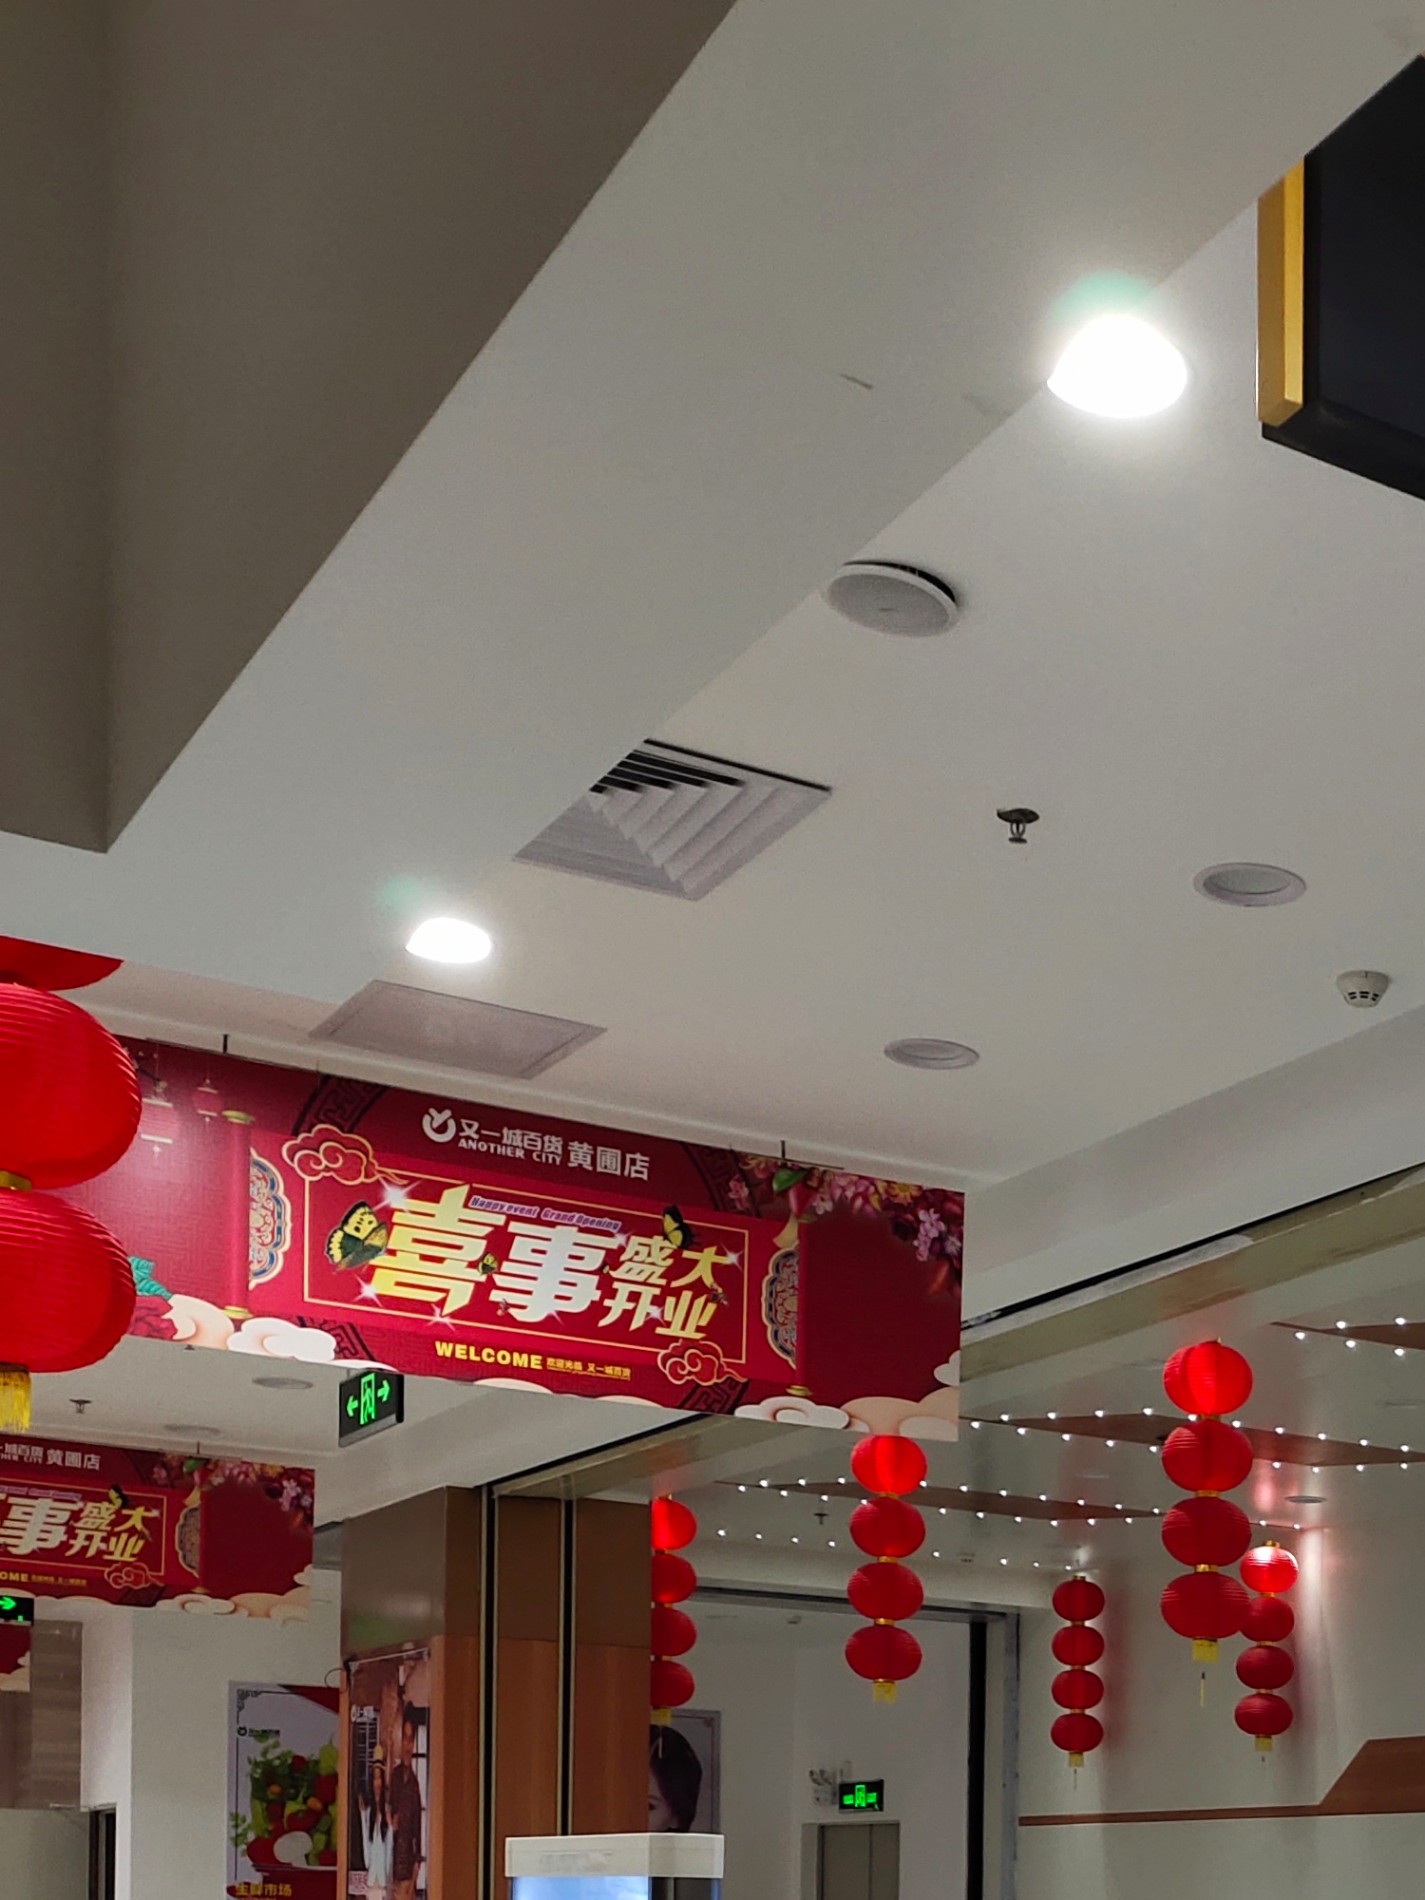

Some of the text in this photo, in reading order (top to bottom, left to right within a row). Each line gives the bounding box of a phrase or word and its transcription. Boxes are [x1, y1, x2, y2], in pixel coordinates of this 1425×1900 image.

[458, 1138, 563, 1166] ANOTHER CITY
[459, 1118, 650, 1181] 又一城百货 黄圃店
[609, 1235, 735, 1287] 盛大
[598, 1282, 718, 1339] 开业
[435, 1341, 543, 1370] WELCOME
